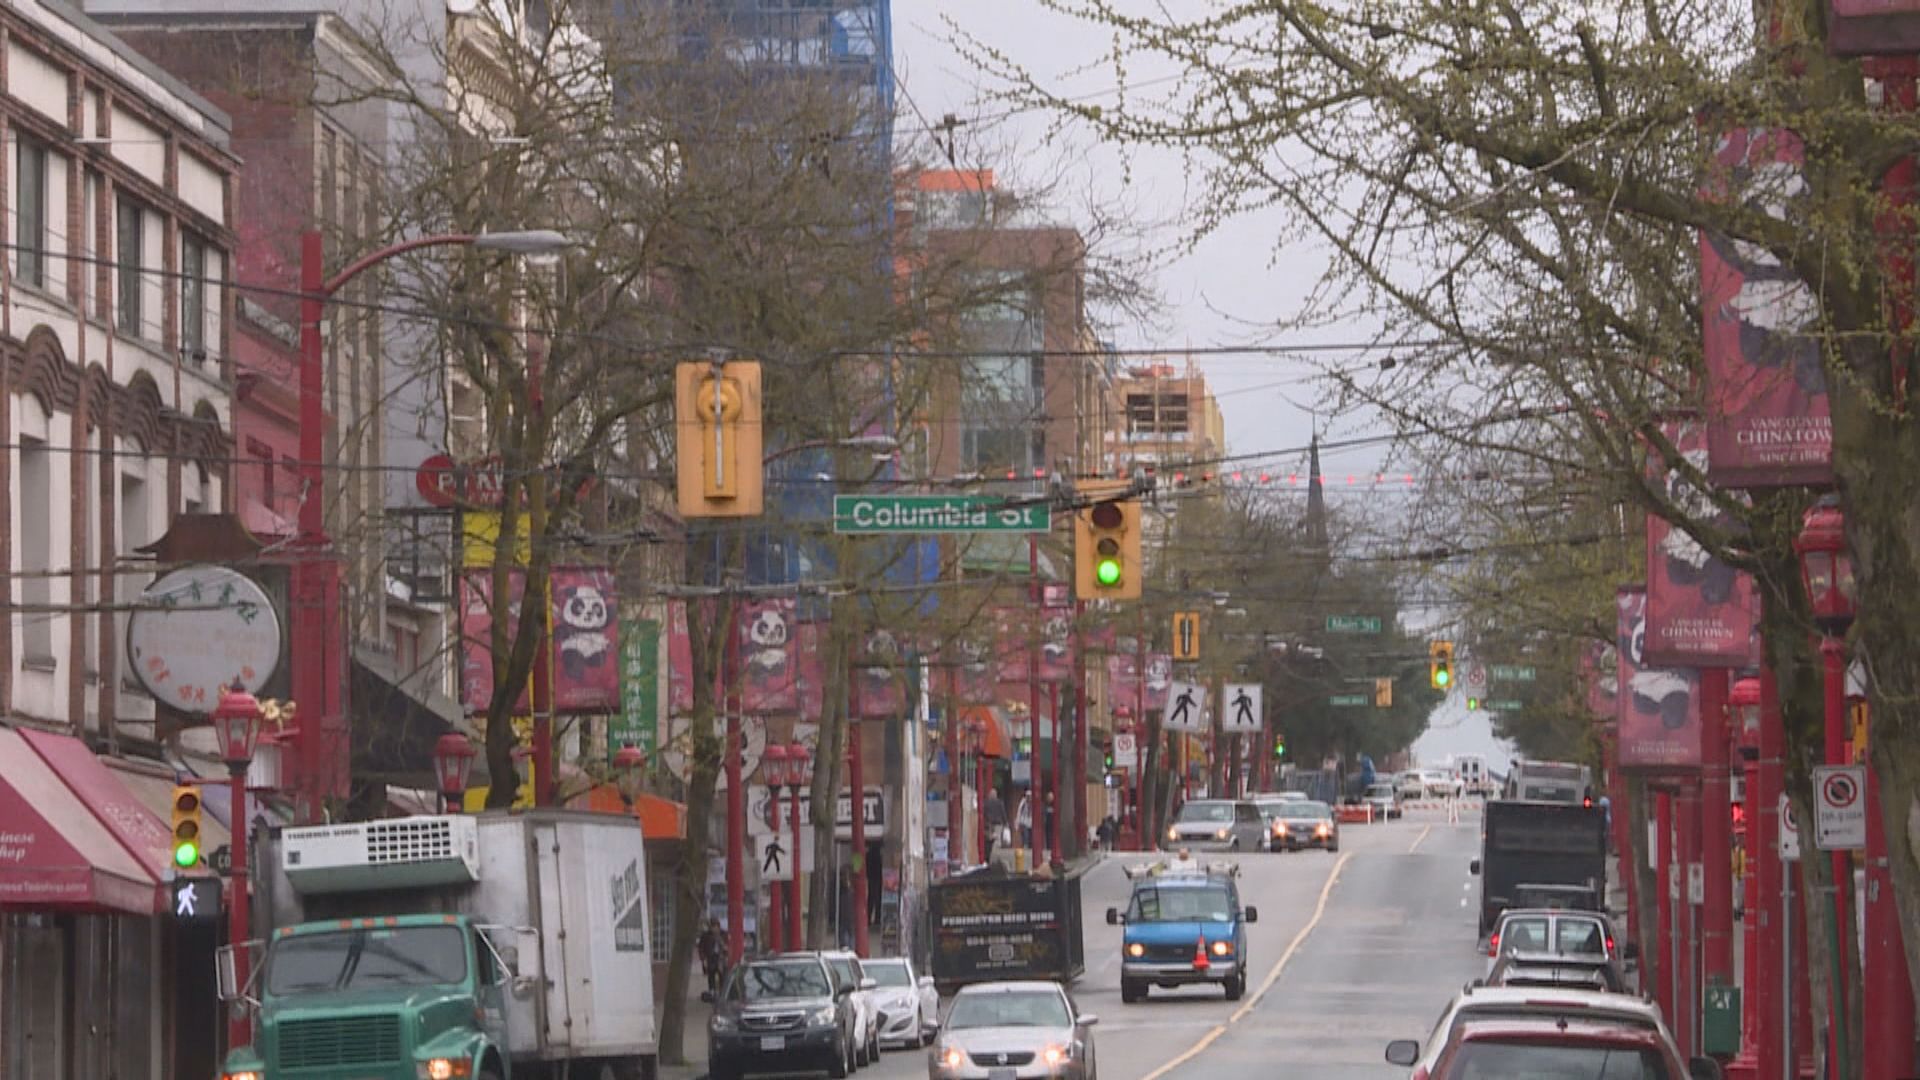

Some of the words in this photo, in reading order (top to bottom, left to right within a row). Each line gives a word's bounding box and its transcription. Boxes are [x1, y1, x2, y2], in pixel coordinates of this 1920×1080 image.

[1737, 429, 1832, 443] CHINATOW
[853, 501, 987, 527] Columbia
[999, 506, 1033, 526] St
